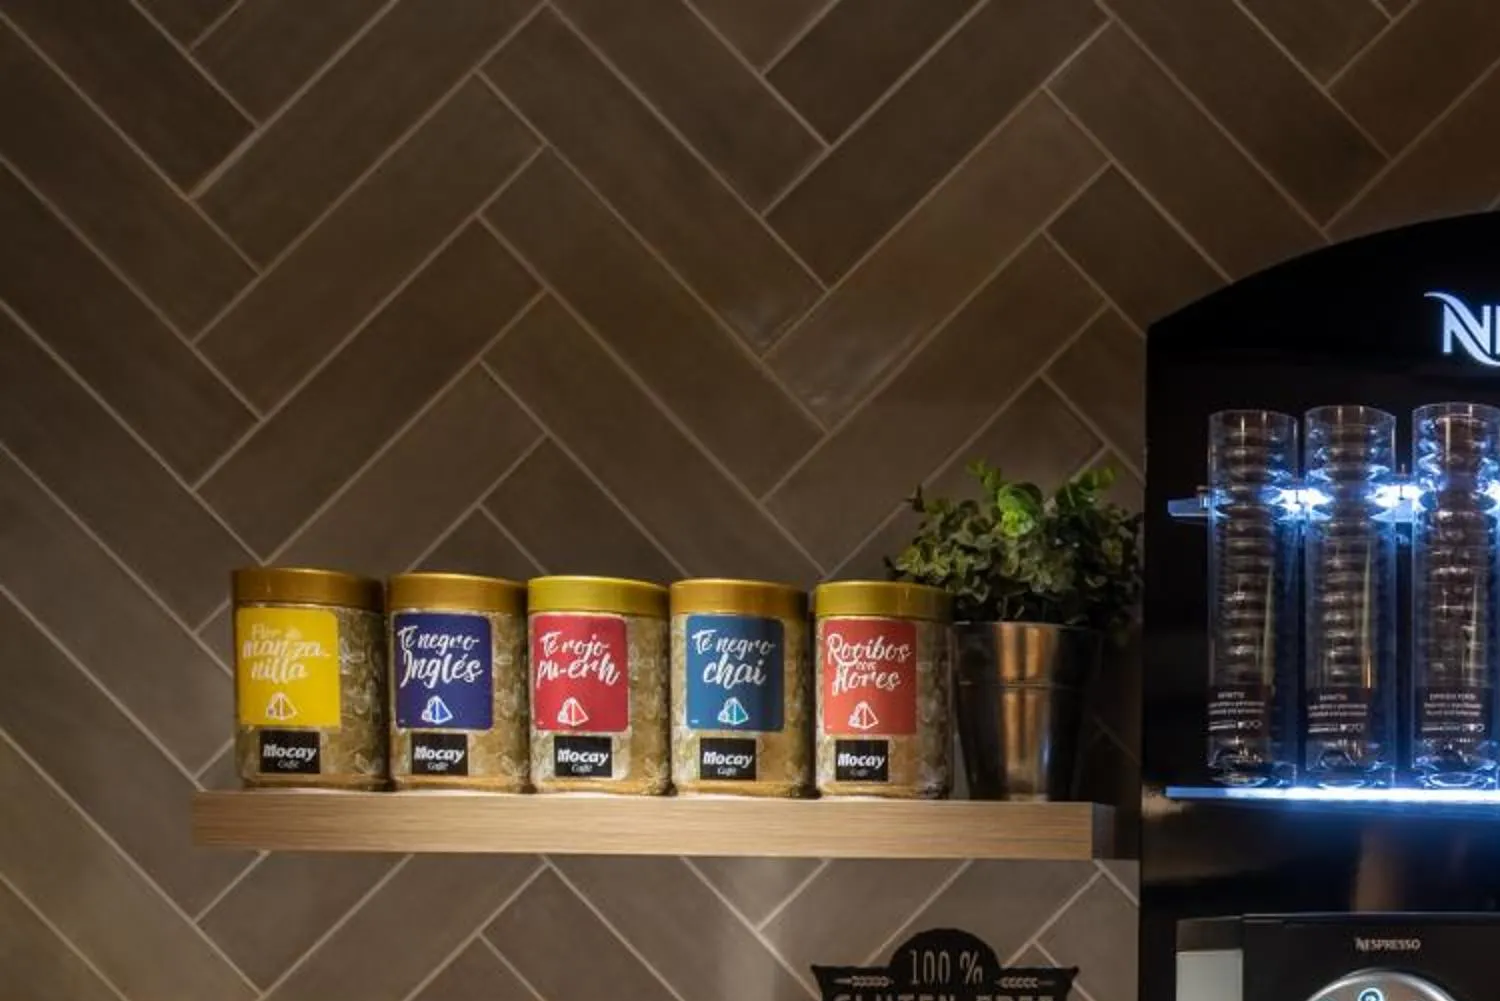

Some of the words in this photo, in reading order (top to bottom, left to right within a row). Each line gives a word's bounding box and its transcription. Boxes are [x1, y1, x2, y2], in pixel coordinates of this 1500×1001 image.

[417, 632, 480, 656] negro
[562, 633, 611, 662] rojo
[716, 636, 777, 661] negro
[703, 653, 767, 689] chai
[263, 744, 317, 762] Mocay
[414, 746, 465, 764] Mocay
[557, 749, 609, 766] Mocay
[703, 752, 753, 769] Mocay
[838, 753, 885, 770] Mocay
[1355, 938, 1421, 950] NESPRESSO
[910, 950, 950, 985] 100
